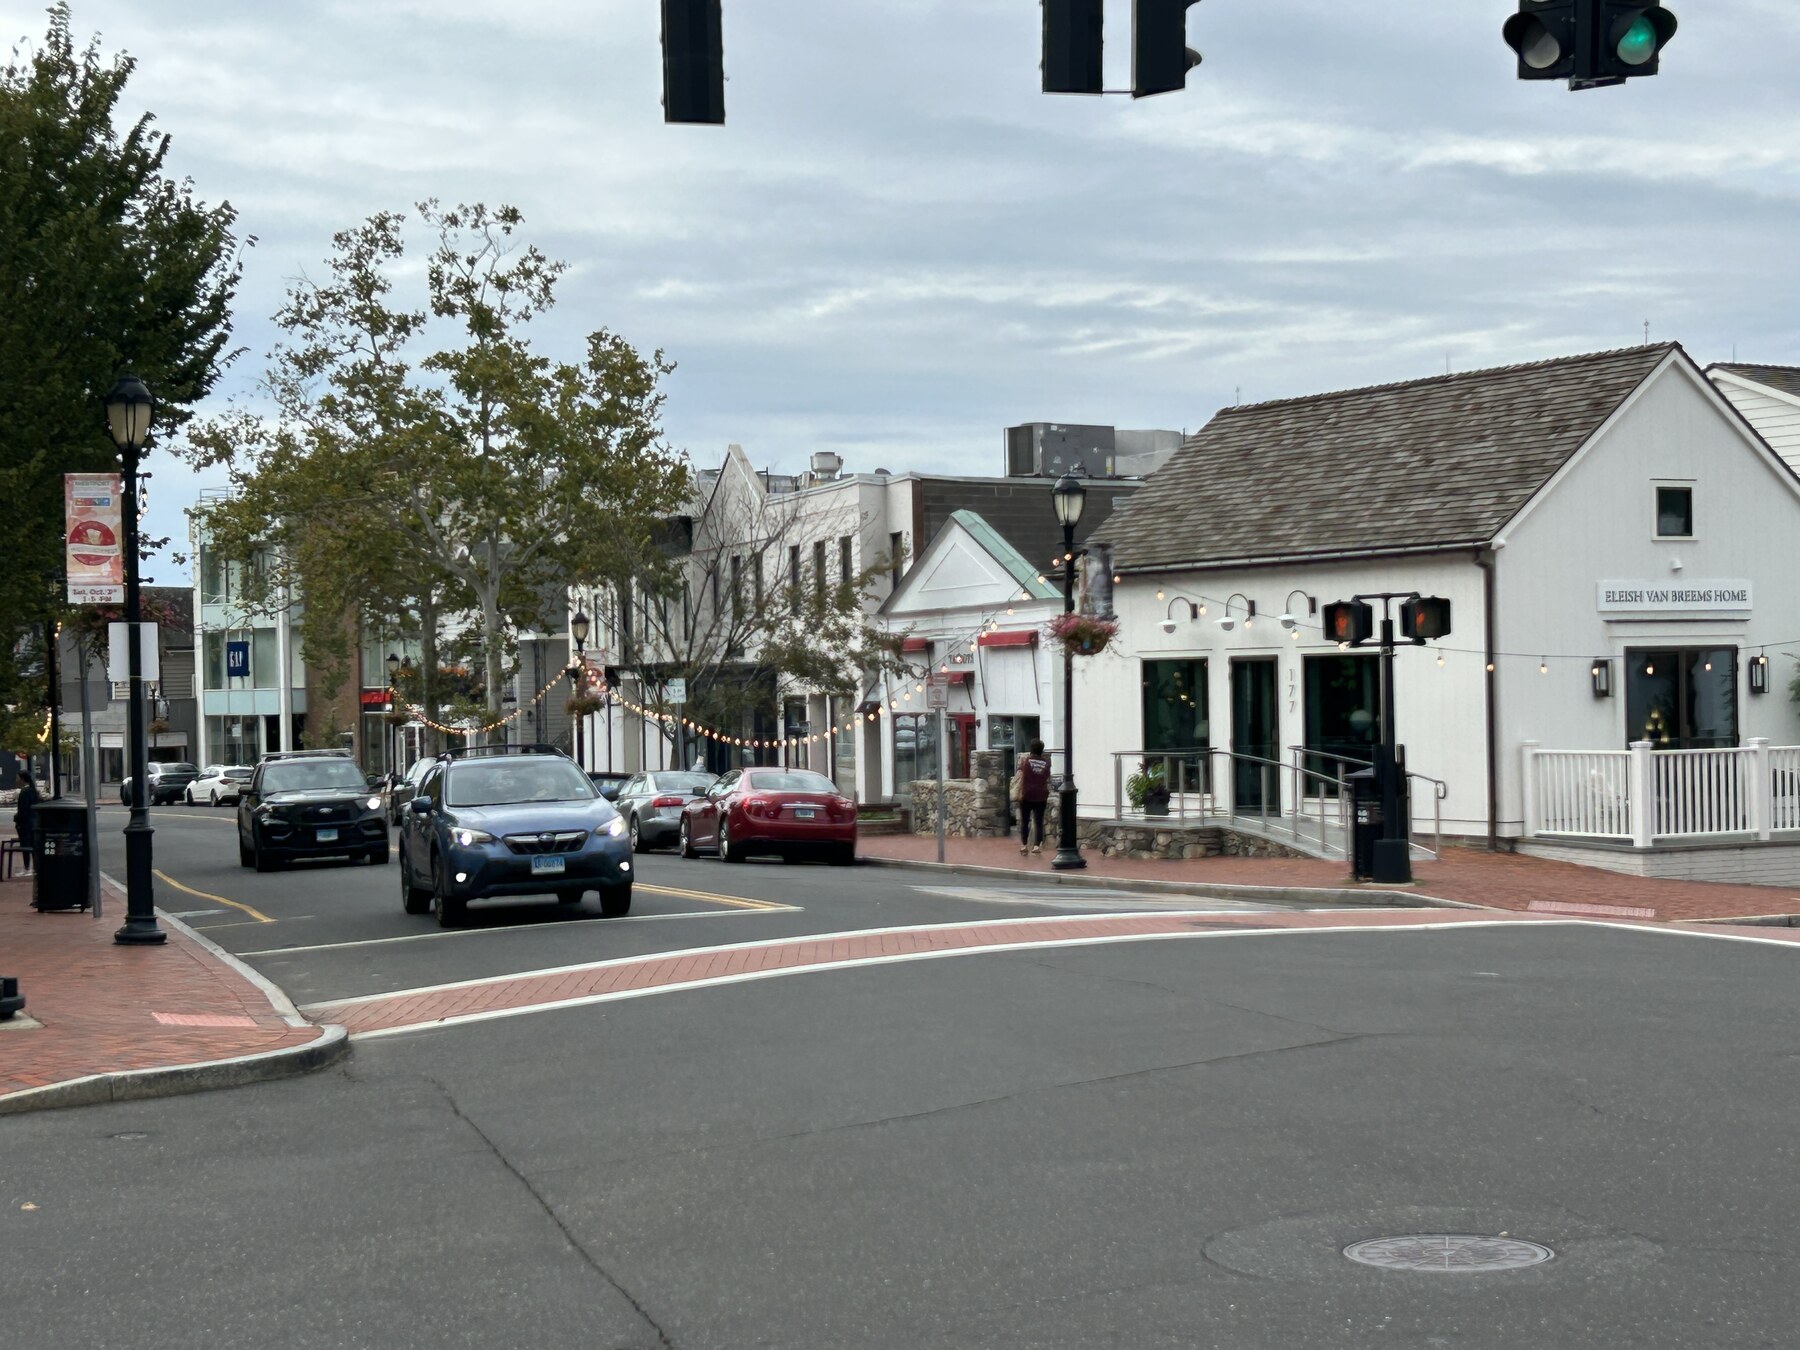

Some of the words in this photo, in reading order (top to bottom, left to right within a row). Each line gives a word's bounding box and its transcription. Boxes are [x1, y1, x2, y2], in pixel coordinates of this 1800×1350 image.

[1605, 590, 1643, 603] ELEISH
[1646, 590, 1669, 602] VAN
[1671, 589, 1713, 602] BREEMS
[1714, 589, 1748, 602] HOME
[1288, 668, 1296, 713] 177
